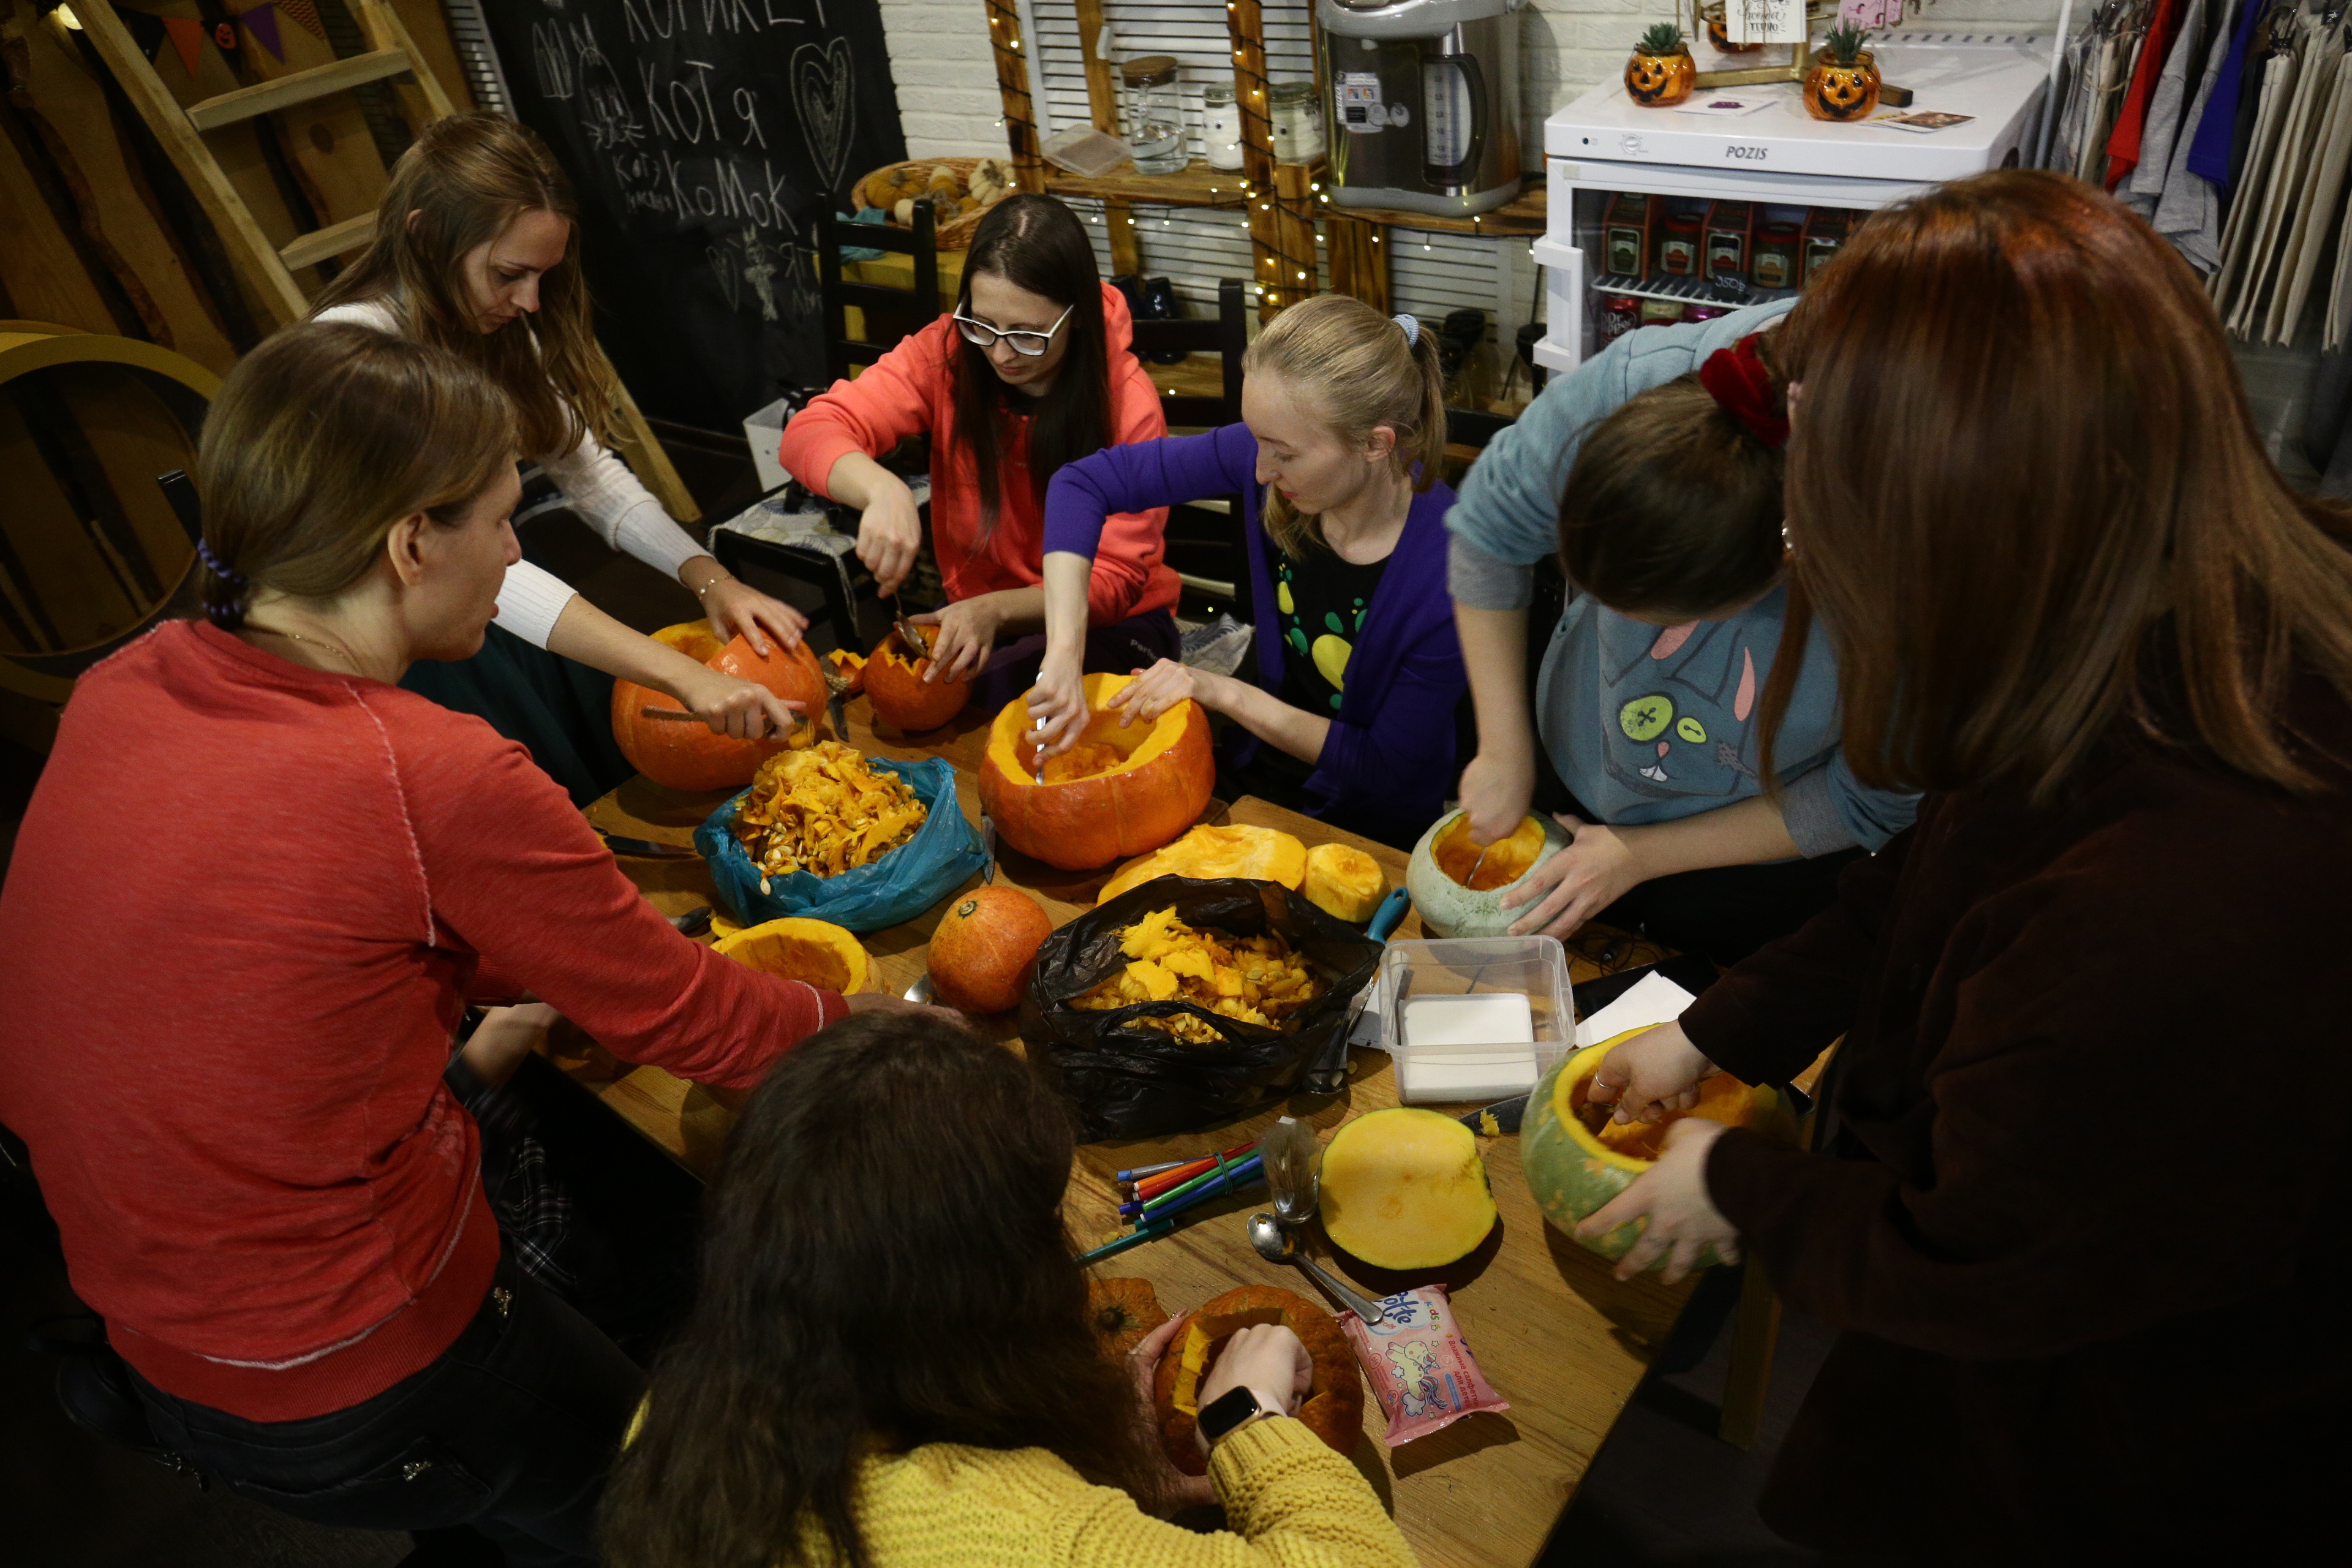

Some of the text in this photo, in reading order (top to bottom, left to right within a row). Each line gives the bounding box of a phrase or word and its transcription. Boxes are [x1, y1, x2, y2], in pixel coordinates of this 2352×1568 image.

[1725, 146, 1768, 159] POZIS
[1449, 1340, 1466, 1370] Влажные
[1463, 1371, 1480, 1407] салфетки
[1453, 1371, 1463, 1385] для
